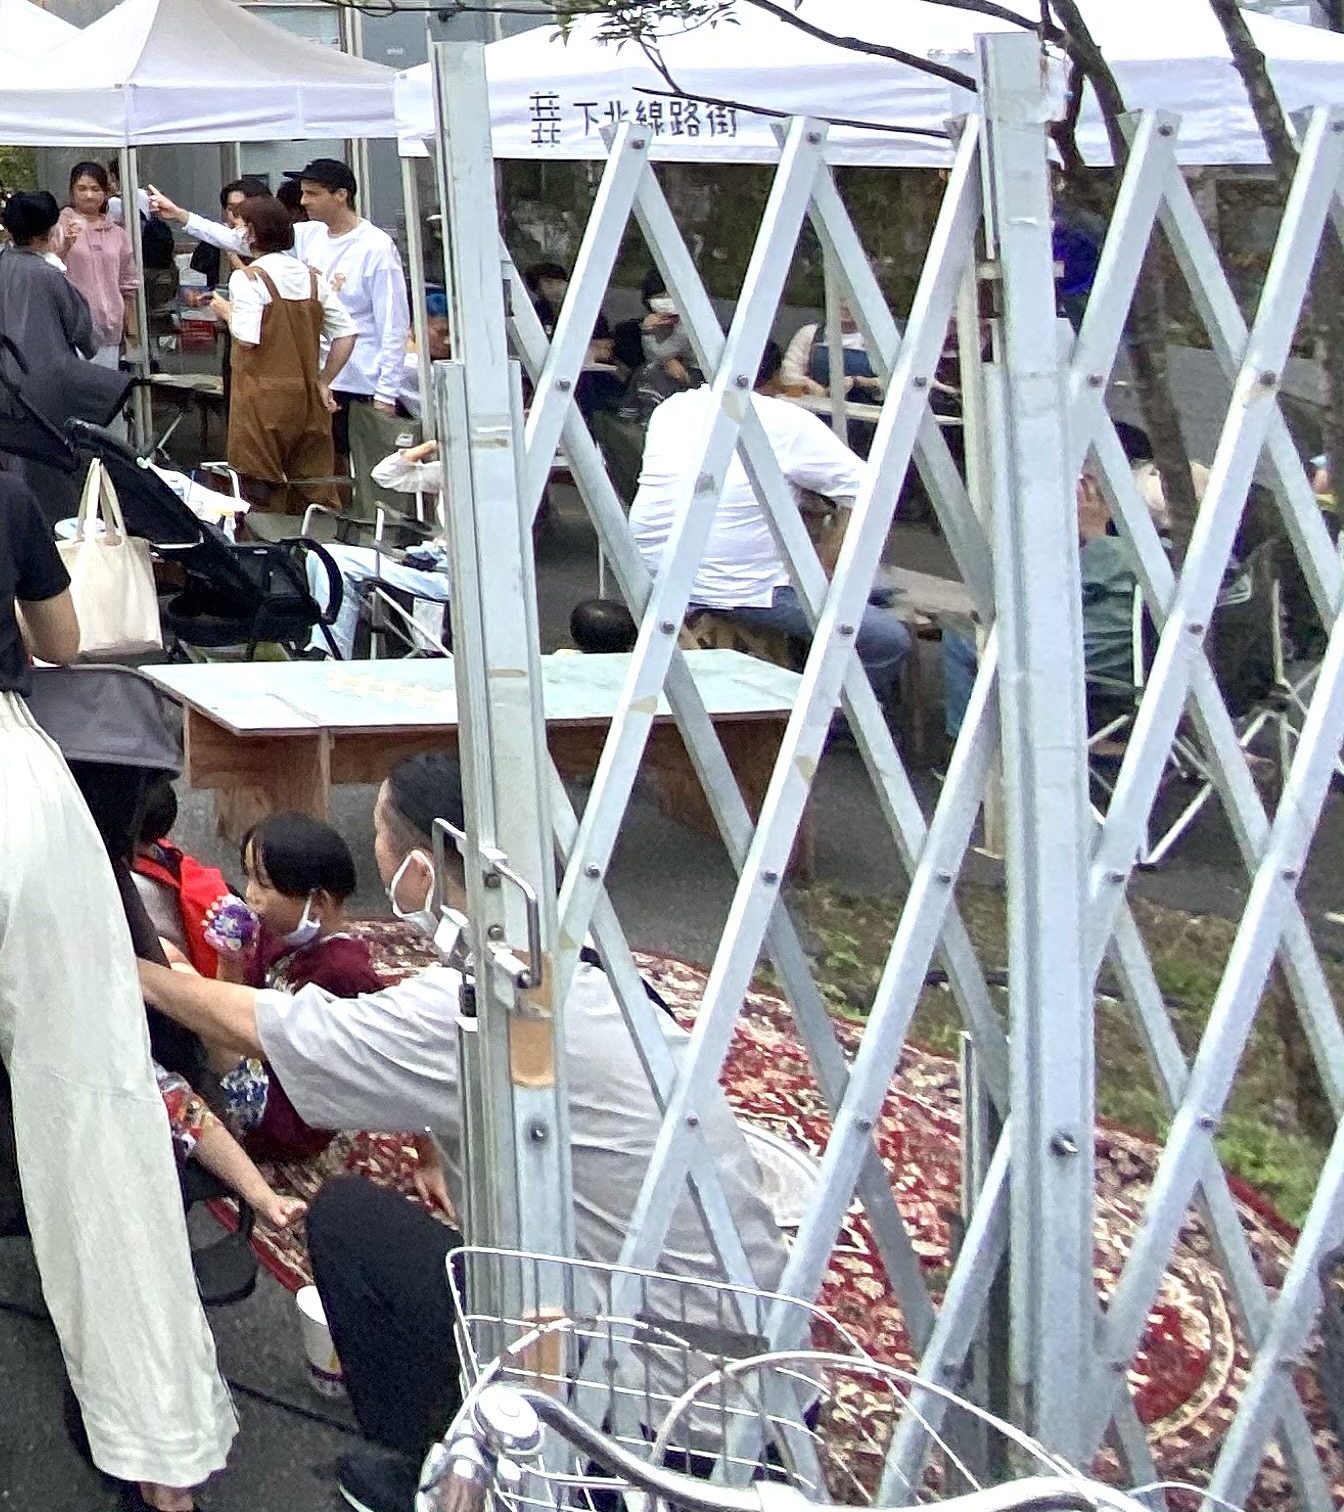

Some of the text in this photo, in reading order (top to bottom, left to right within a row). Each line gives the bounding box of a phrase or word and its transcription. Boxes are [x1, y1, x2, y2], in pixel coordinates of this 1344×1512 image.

[573, 99, 737, 138] 下北線路街
